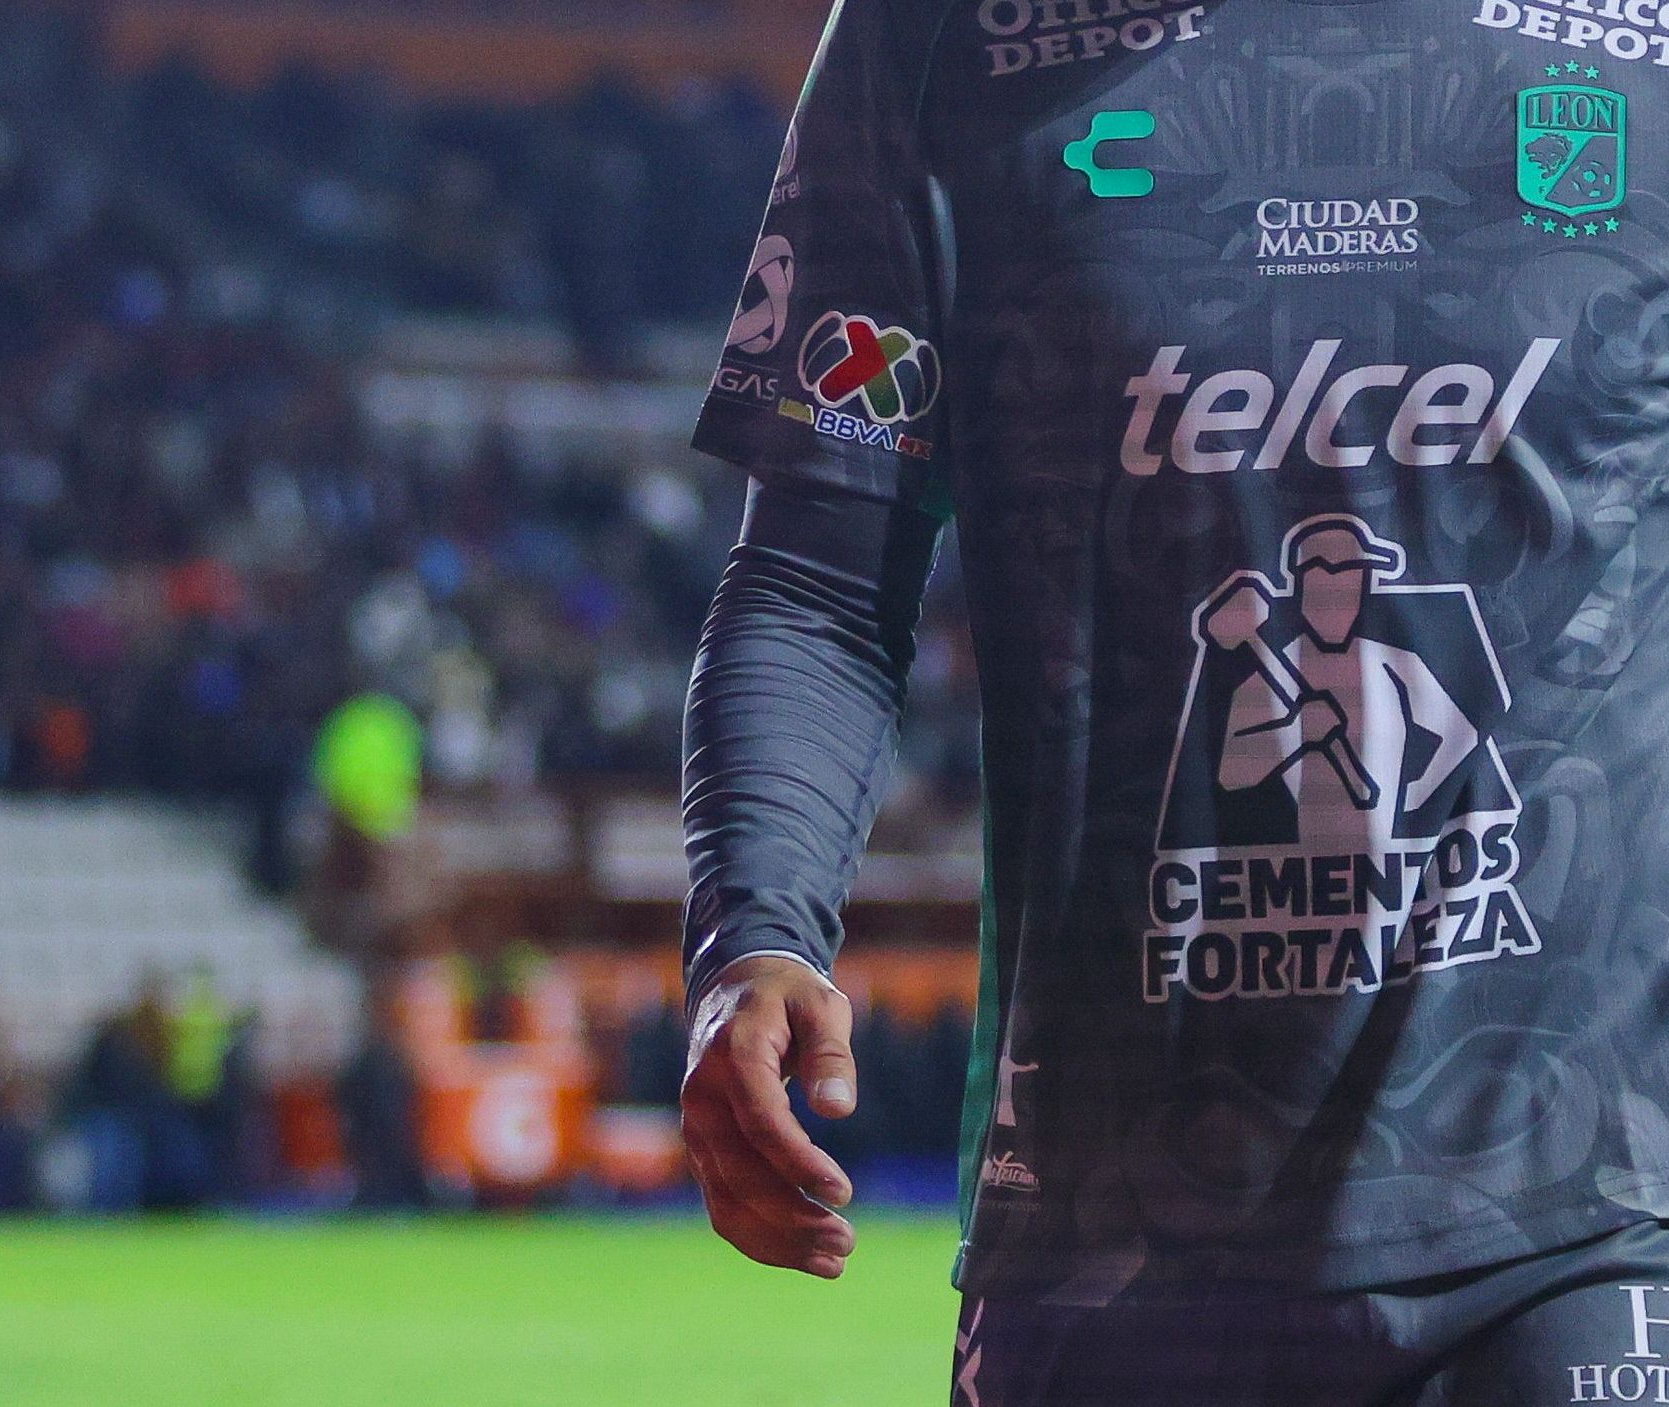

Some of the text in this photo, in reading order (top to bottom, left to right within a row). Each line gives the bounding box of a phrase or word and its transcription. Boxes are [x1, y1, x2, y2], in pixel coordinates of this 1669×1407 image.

[985, 5, 1205, 77] DEPOT
[1256, 198, 1419, 229] CIUDAD
[1256, 228, 1420, 258] MADERAS
[1258, 262, 1341, 276] TERRENOS
[1346, 261, 1418, 273] PREMIUM
[1120, 338, 1562, 476] telcel
[815, 409, 894, 451] BBVA
[1152, 823, 1519, 924] CEMENTOS
[1147, 889, 1534, 997] FORTALEZA
